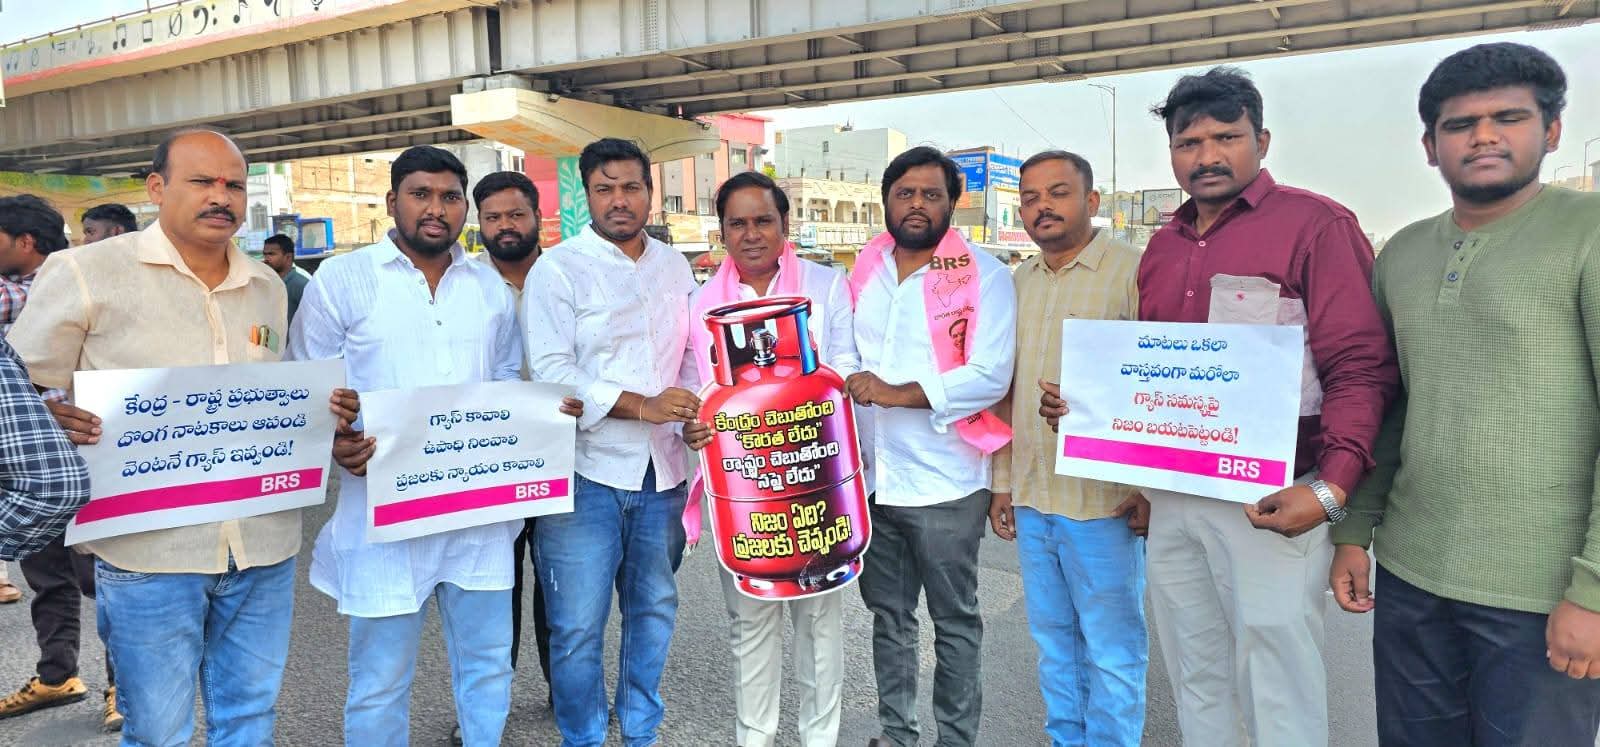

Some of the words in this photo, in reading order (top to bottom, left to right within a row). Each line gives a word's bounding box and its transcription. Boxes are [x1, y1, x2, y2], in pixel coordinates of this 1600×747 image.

[930, 254, 970, 270] BRS
[1138, 335, 1189, 350] మాటలు
[1191, 338, 1228, 352] ఒకలా
[1120, 363, 1187, 382] వాస్తవంగా
[1189, 365, 1240, 382] మరోలా
[124, 393, 167, 417] కేంద్ర
[186, 389, 222, 414] రాష్ట్ర
[227, 387, 310, 408] ప్రభుత్వాలు
[1134, 391, 1163, 412] గ్యాస్
[1167, 395, 1220, 417] సమస్యపై
[430, 410, 463, 430] గ్యాస్
[465, 409, 510, 423] కావాలి
[715, 412, 761, 432] కేంద్రం
[765, 400, 835, 425] చెబుతోంది
[117, 426, 168, 448] దొంగ
[172, 418, 248, 439] నాటకాలు
[252, 413, 307, 430] ఆపండి
[1112, 418, 1144, 432] నిజం
[1146, 422, 1239, 446] బయటపెట్టండి!
[122, 450, 182, 477] వెంటనే
[186, 448, 226, 472] గ్యాస్
[230, 440, 293, 465] ఇవ్వండి!
[423, 439, 465, 455] ఉపాధి
[722, 455, 766, 478] రాష్ట్రం
[770, 441, 839, 467] చెబుతోంది
[396, 470, 445, 491] ప్రజలకు
[447, 462, 499, 483] న్యాయం
[503, 457, 545, 472] కావాలి
[1217, 457, 1261, 479] BRS
[261, 473, 301, 493] BRS
[515, 483, 550, 500] BRS
[750, 512, 788, 533] నిజం
[791, 501, 827, 529] ఏది?
[732, 533, 793, 559] ప్రజలకు
[798, 516, 852, 555] చెప్పండి!
